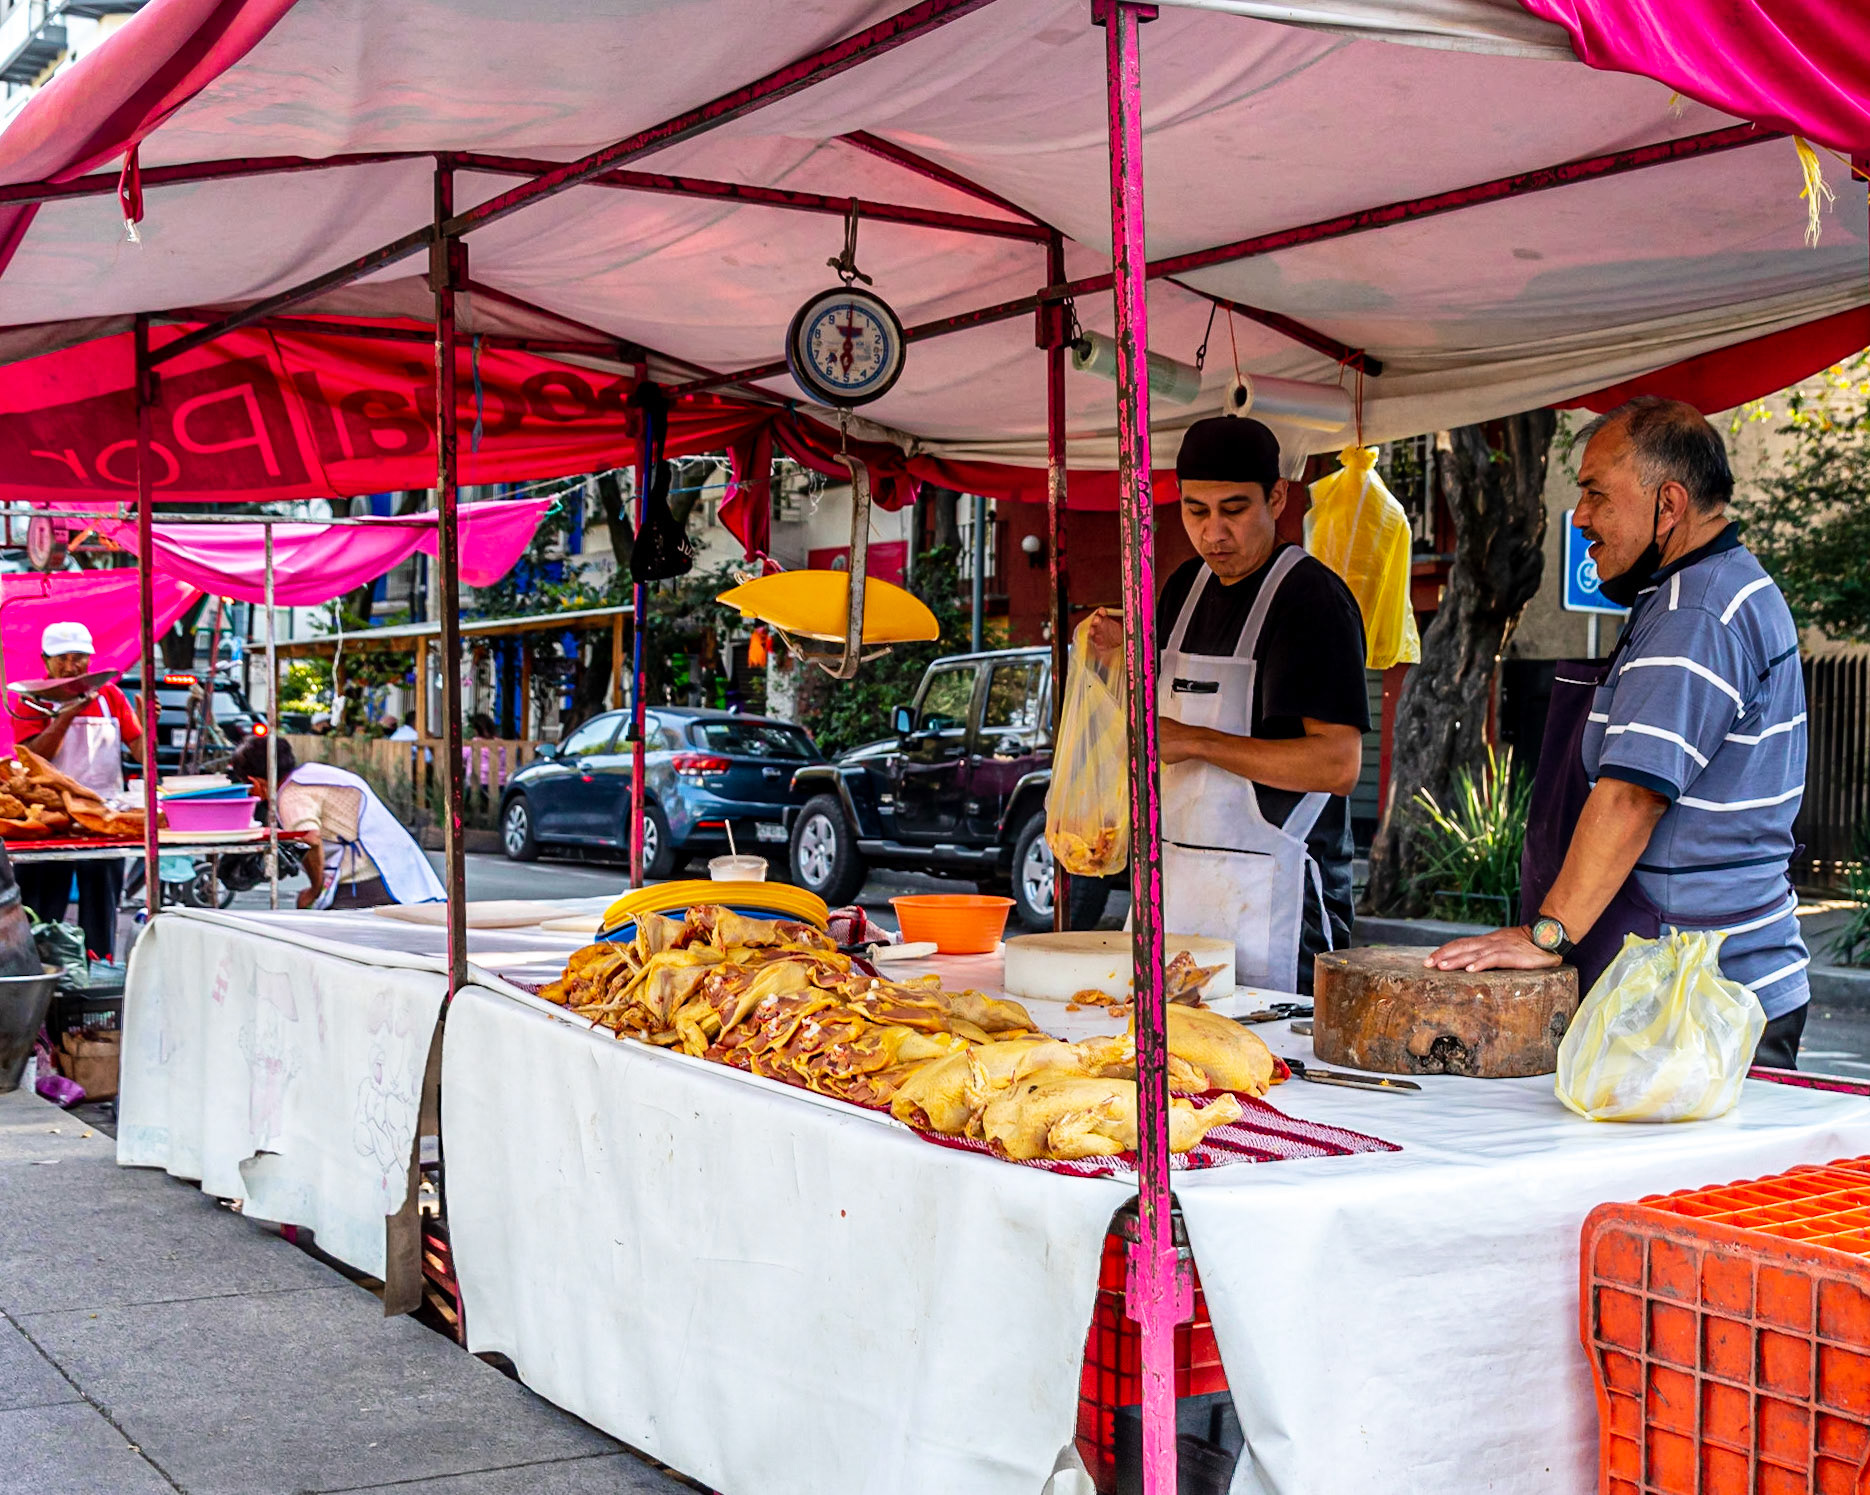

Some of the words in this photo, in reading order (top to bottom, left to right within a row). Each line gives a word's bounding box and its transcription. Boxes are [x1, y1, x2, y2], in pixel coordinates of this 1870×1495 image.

[829, 314, 835, 325] 9
[866, 318, 870, 328] 1
[815, 329, 821, 339] 8
[874, 335, 881, 344] 2
[813, 350, 820, 359] 7
[874, 354, 881, 364] 3
[826, 366, 833, 376] 6
[860, 369, 867, 379] 4
[843, 373, 850, 382] 5
